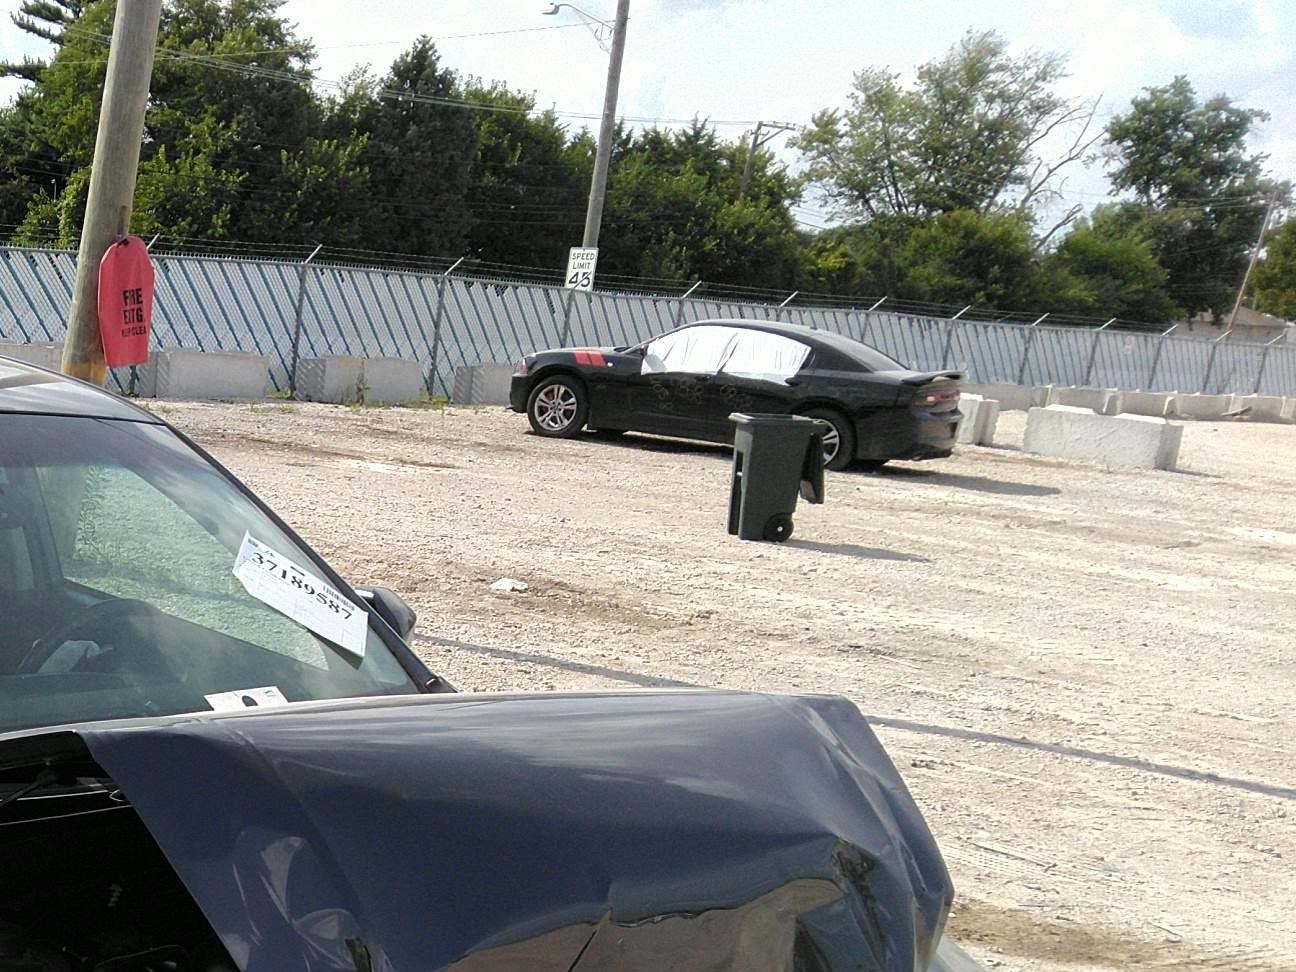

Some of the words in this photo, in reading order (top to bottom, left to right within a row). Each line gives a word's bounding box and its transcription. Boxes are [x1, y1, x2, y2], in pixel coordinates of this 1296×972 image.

[572, 252, 596, 261] SPEED
[572, 262, 592, 270] LIMIT
[568, 271, 592, 288] 45
[251, 551, 352, 620] 37189587
